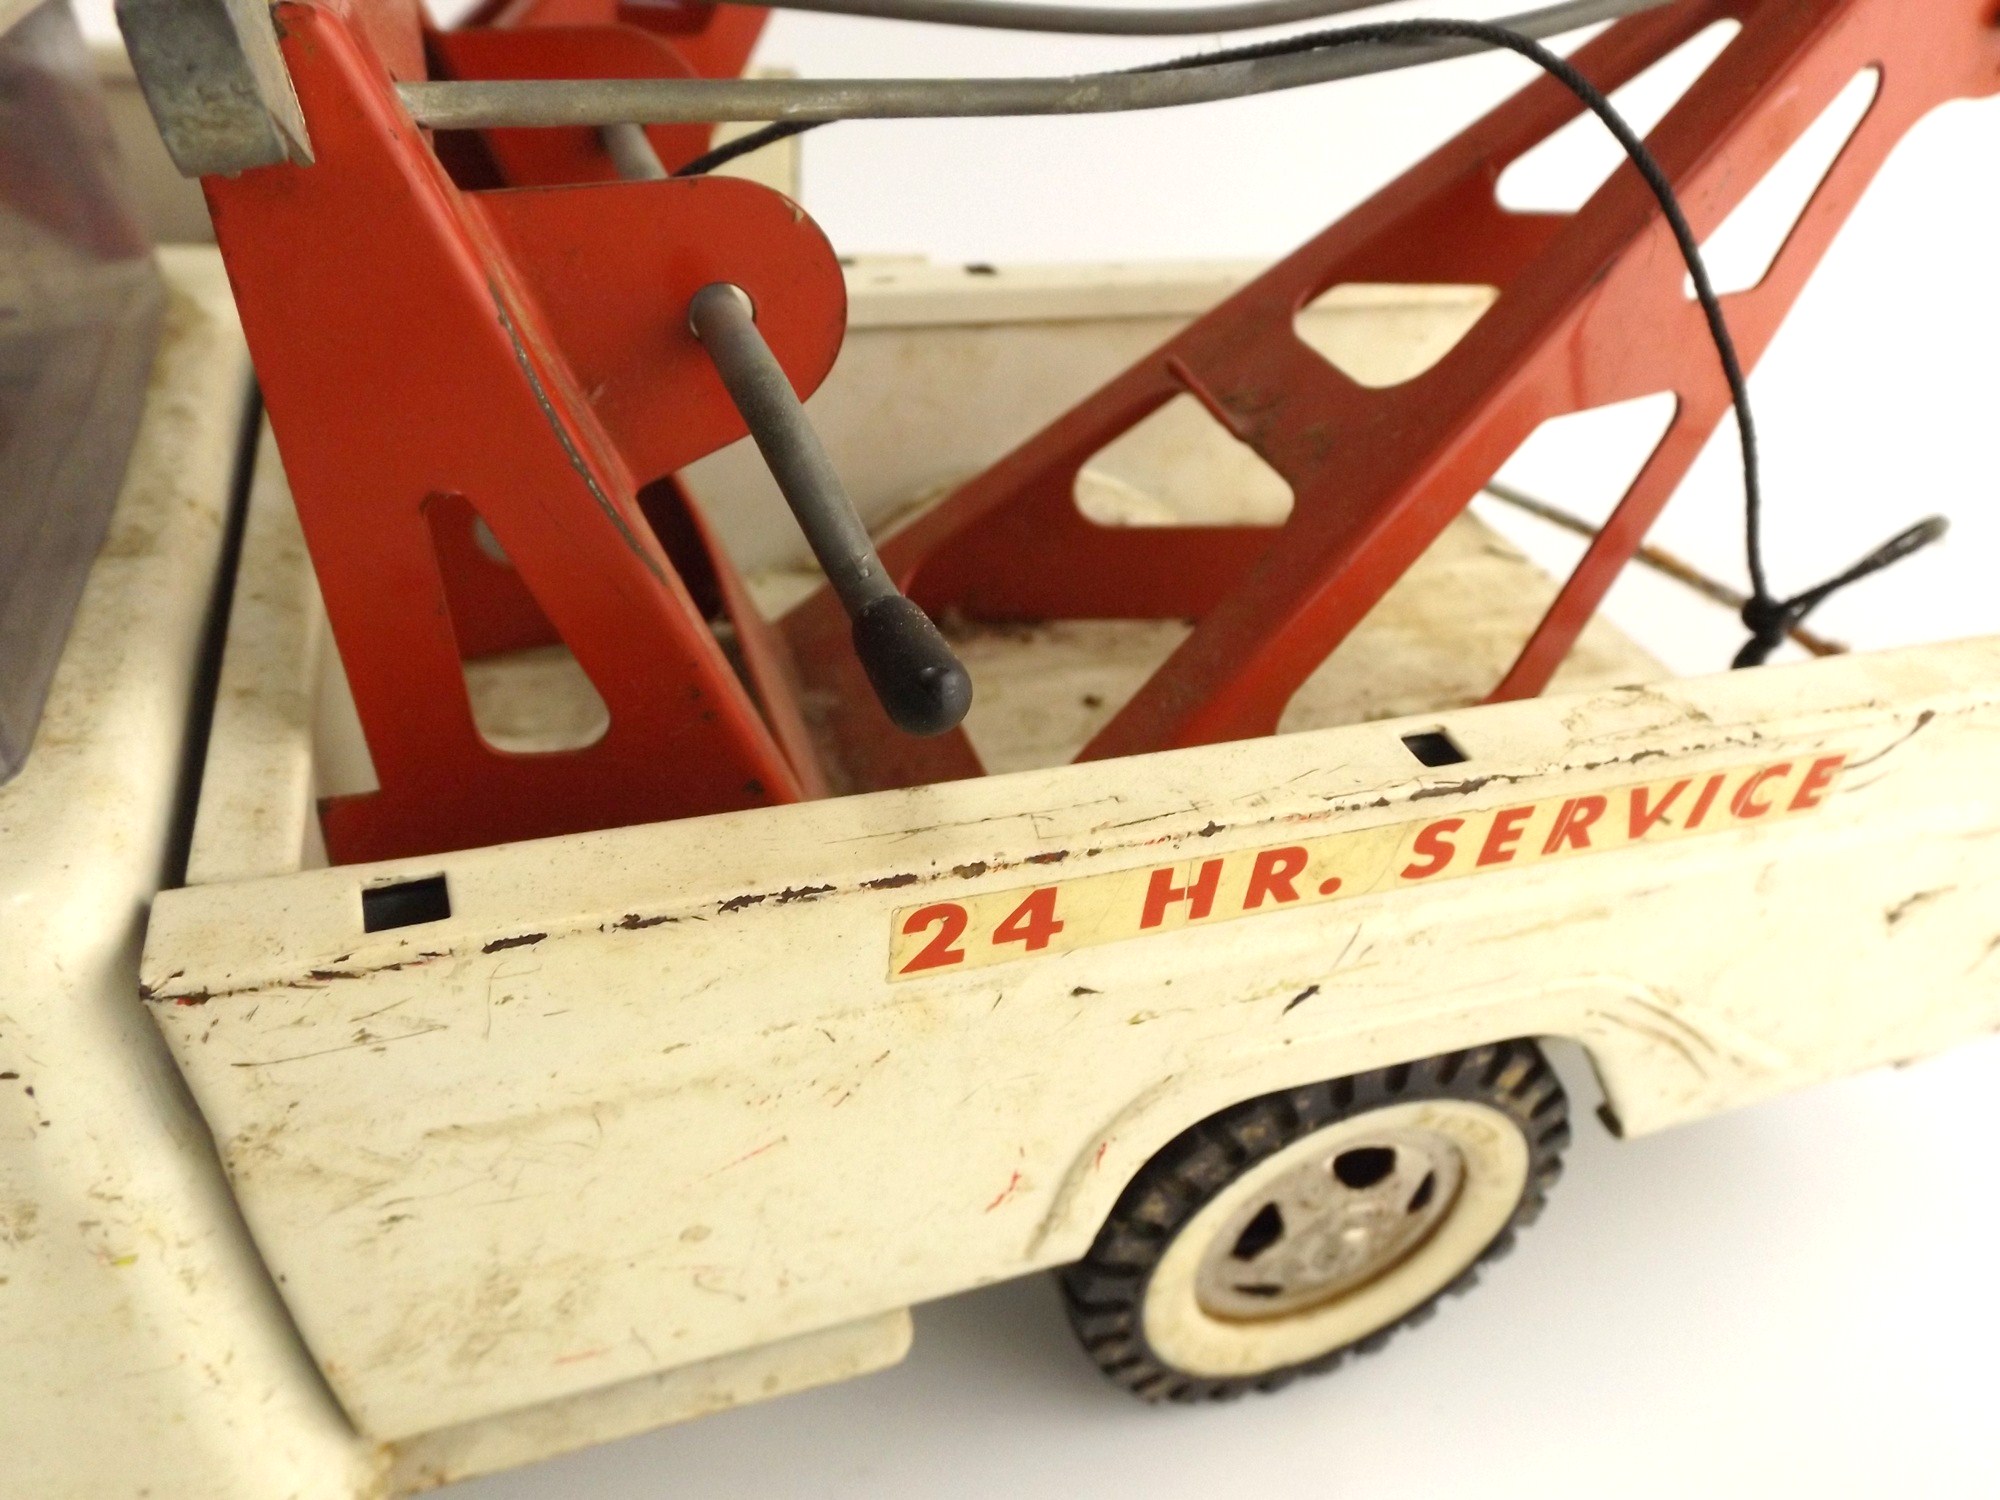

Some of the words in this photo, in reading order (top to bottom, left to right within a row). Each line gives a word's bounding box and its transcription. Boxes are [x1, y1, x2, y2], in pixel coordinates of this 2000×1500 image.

[899, 886, 1064, 975] 24
[1140, 846, 1341, 929] HR.
[1400, 755, 1845, 880] SERVICE
